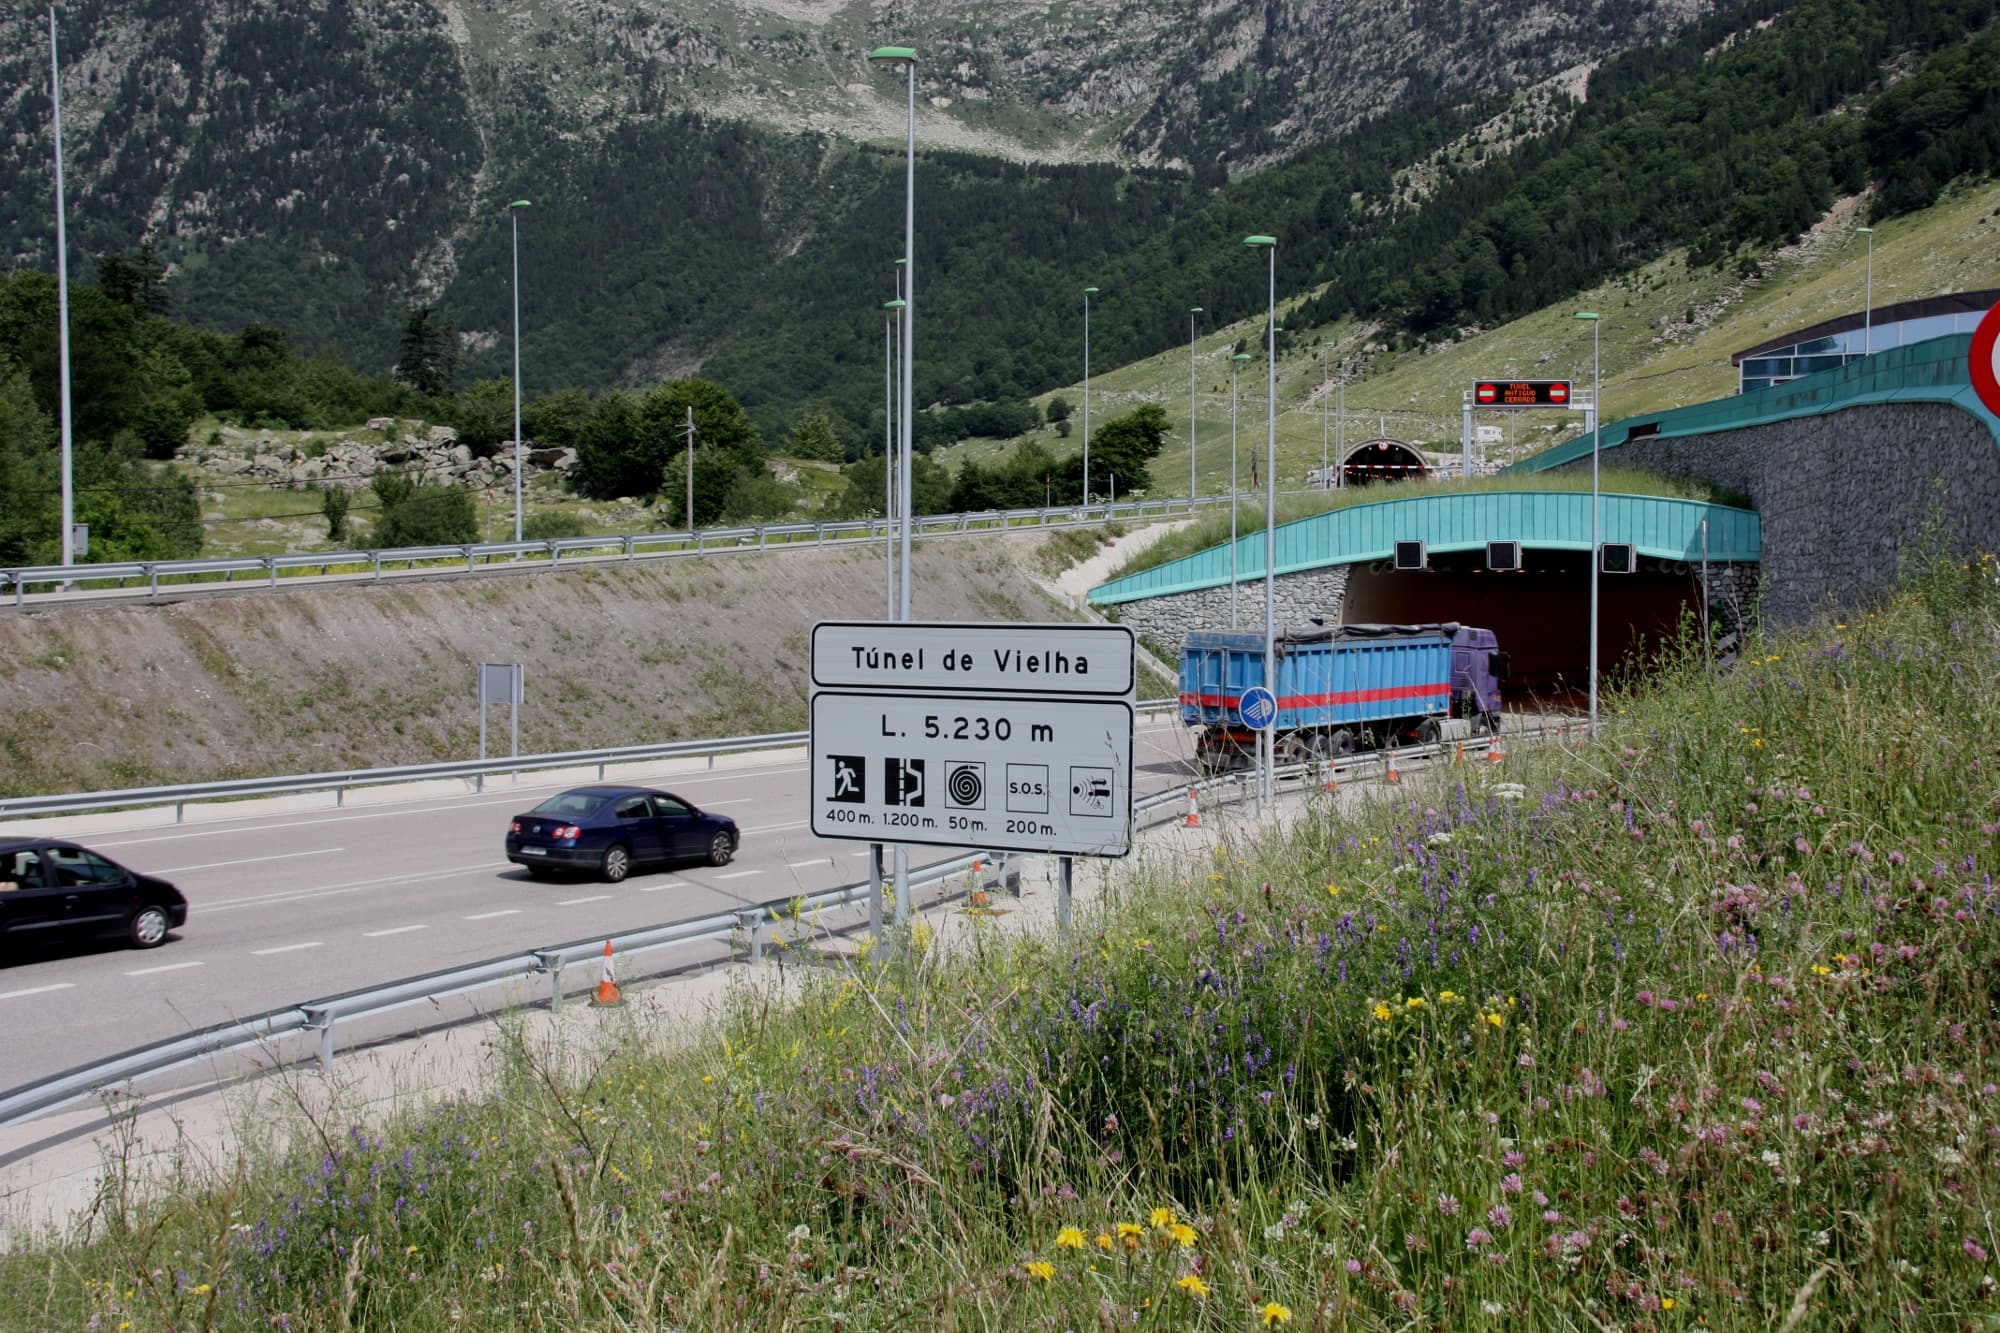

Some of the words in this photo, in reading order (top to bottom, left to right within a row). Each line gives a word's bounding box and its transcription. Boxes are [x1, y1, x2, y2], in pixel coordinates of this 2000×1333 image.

[851, 646, 924, 670] Túnel
[942, 649, 973, 671] de
[994, 649, 1088, 674] Vielha
[881, 714, 906, 737] L.
[925, 715, 1012, 741] 5.230
[1032, 724, 1054, 742] m
[1009, 783, 1046, 795] S.O.S.
[826, 808, 857, 823] 400
[858, 814, 874, 825] m.
[882, 812, 919, 827] 1.200
[922, 817, 938, 829] m.
[949, 816, 968, 830] 50
[1006, 820, 1038, 835] 200
[1040, 824, 1057, 836] m.
